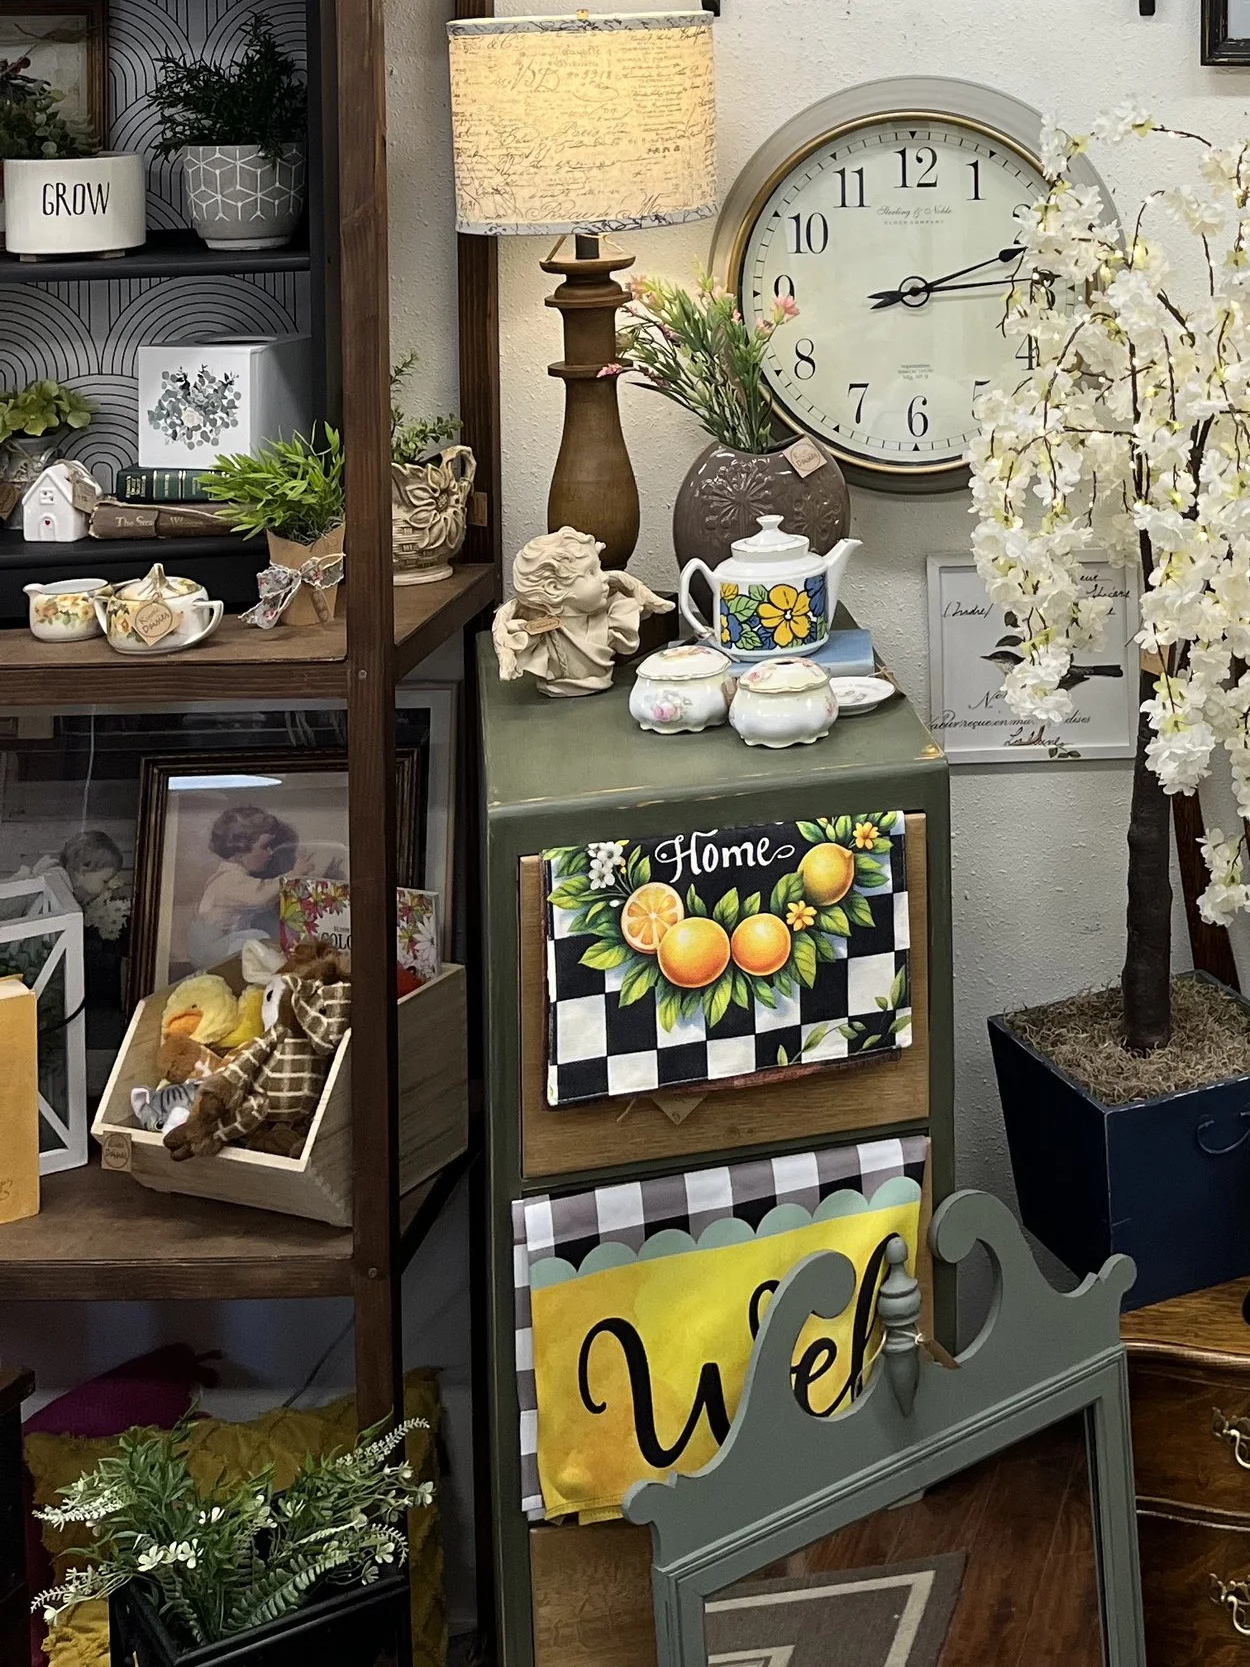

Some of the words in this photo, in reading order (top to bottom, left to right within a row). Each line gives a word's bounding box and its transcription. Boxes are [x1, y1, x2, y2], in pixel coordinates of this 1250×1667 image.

[832, 166, 870, 208] 11
[893, 146, 938, 188] 12
[965, 159, 986, 200] 1
[42, 181, 110, 216] GROW
[787, 212, 829, 254] 10
[793, 338, 816, 380] 8
[847, 383, 869, 424] 7
[906, 395, 929, 438] 6
[655, 829, 796, 883] Home
